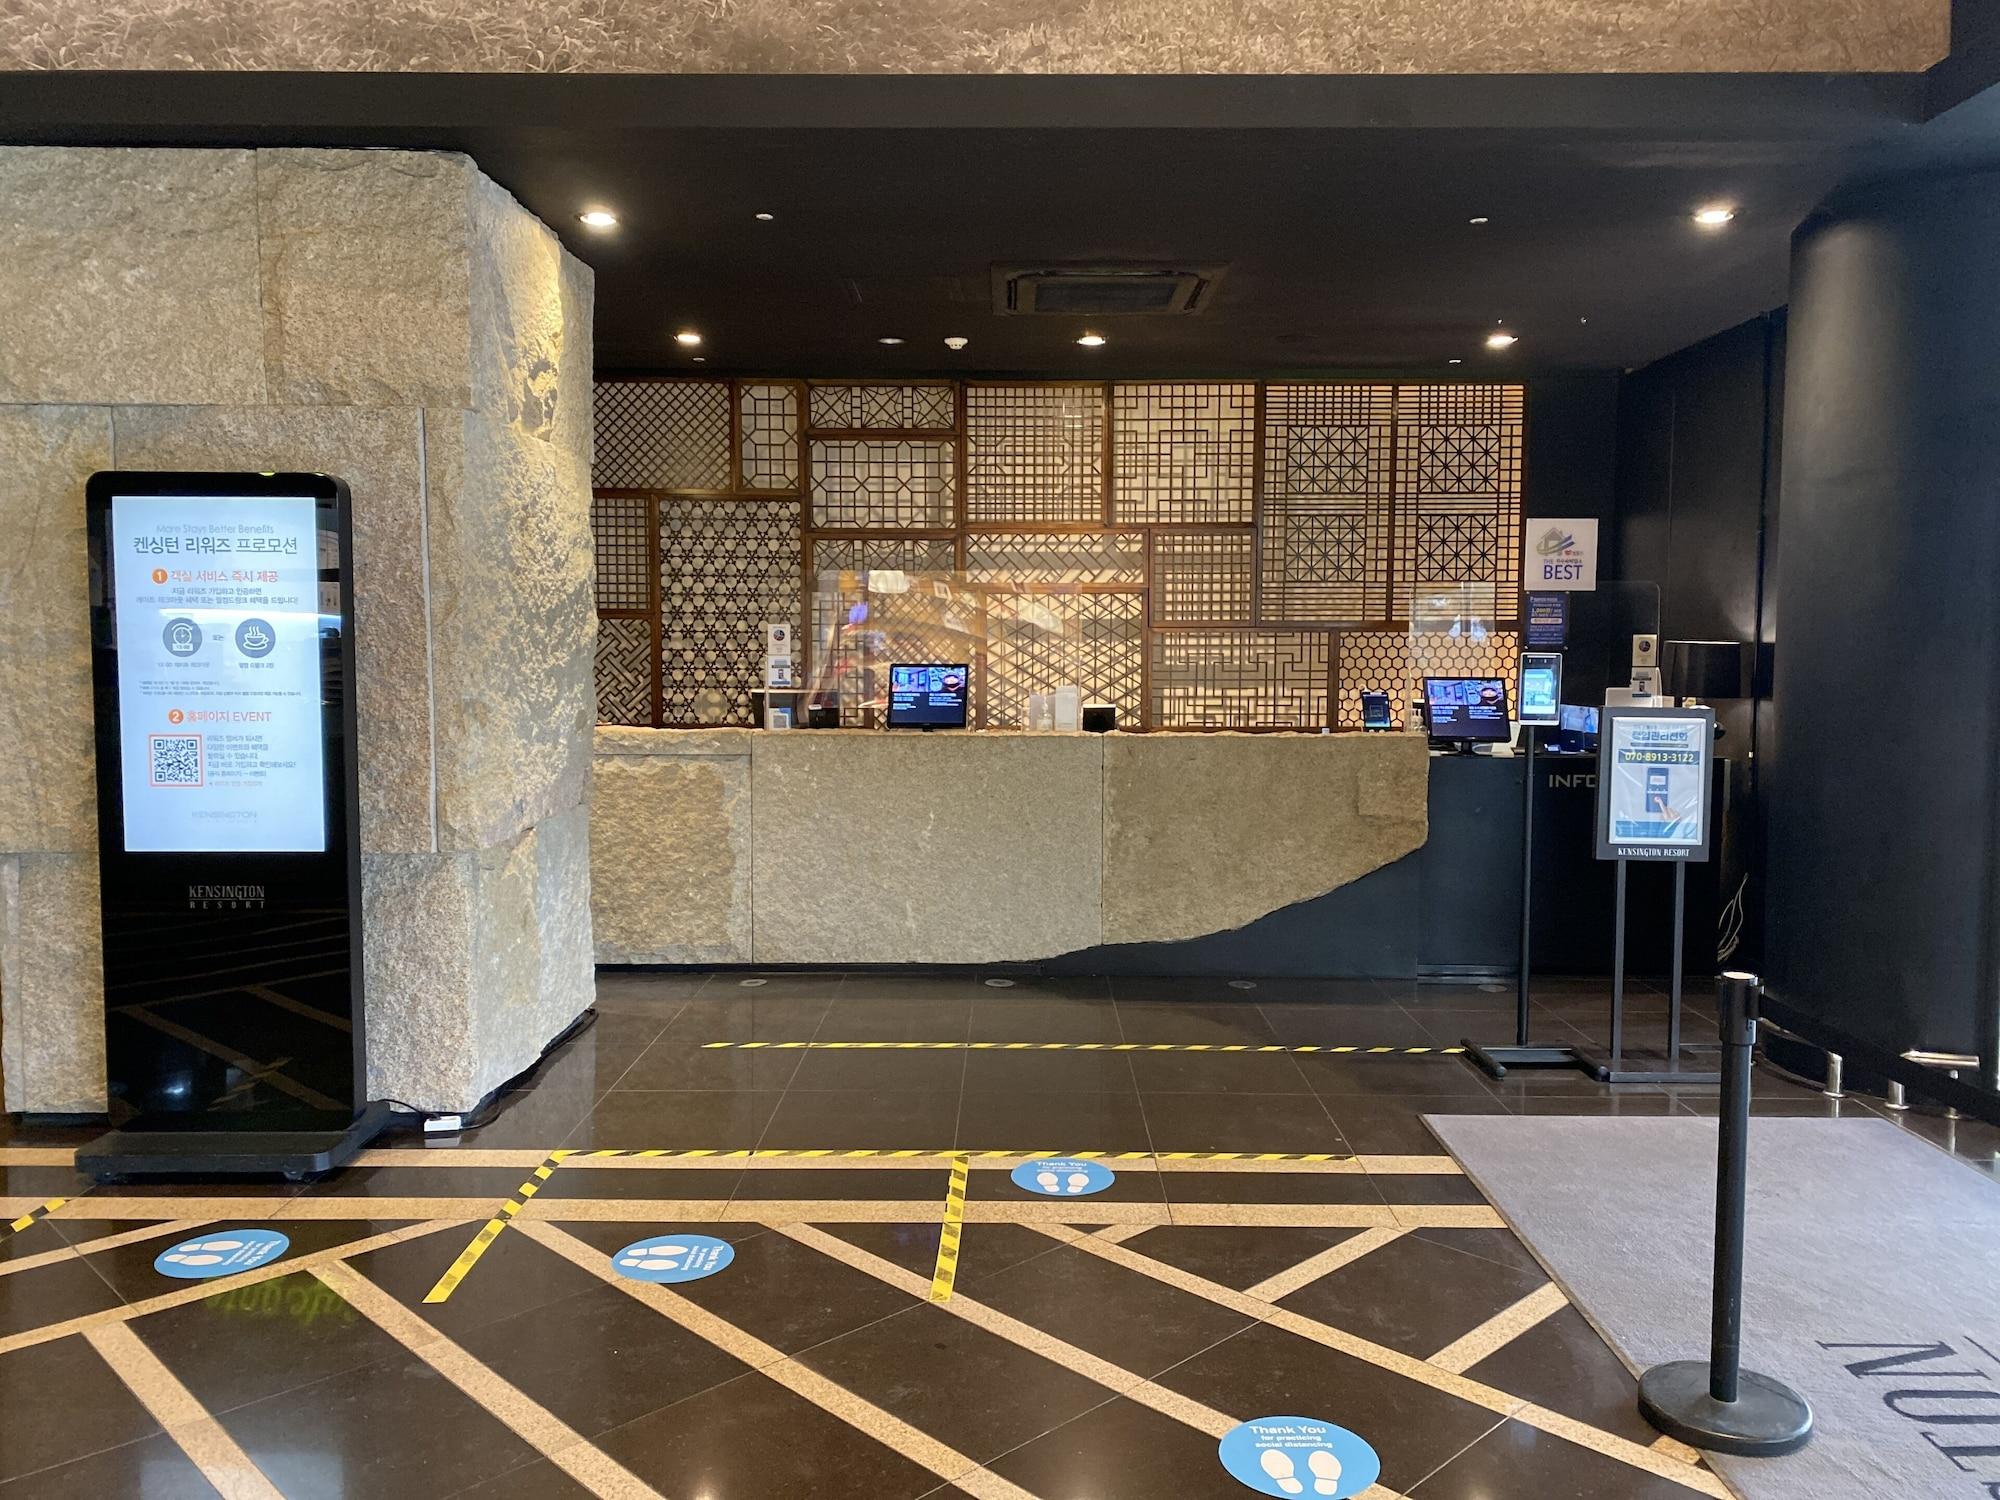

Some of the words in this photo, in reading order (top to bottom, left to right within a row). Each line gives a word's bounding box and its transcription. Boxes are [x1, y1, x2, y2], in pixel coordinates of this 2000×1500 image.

[183, 524, 206, 535] Stays
[209, 524, 236, 534] Better
[239, 524, 274, 534] Benefits
[133, 536, 180, 555] 켄싱턴
[185, 536, 232, 555] 리워즈
[235, 537, 298, 555] 프로모션
[170, 570, 192, 583] 객실
[196, 570, 229, 583] 서비스
[231, 570, 254, 583] 즉시
[256, 570, 279, 583] 제공
[1543, 564, 1584, 580] BEST
[187, 711, 230, 723] 홈페이지
[233, 711, 272, 722] EVENT
[1624, 751, 1695, 762] 070-8913-3122
[1617, 848, 1662, 857] KENSINGTON
[1663, 848, 1690, 857] RESORT
[188, 885, 265, 899] KENSINGTON
[189, 901, 265, 909] RESORT
[1248, 1425, 1296, 1435] Thank
[1298, 1425, 1327, 1434] You
[1284, 1441, 1333, 1449] distancing
